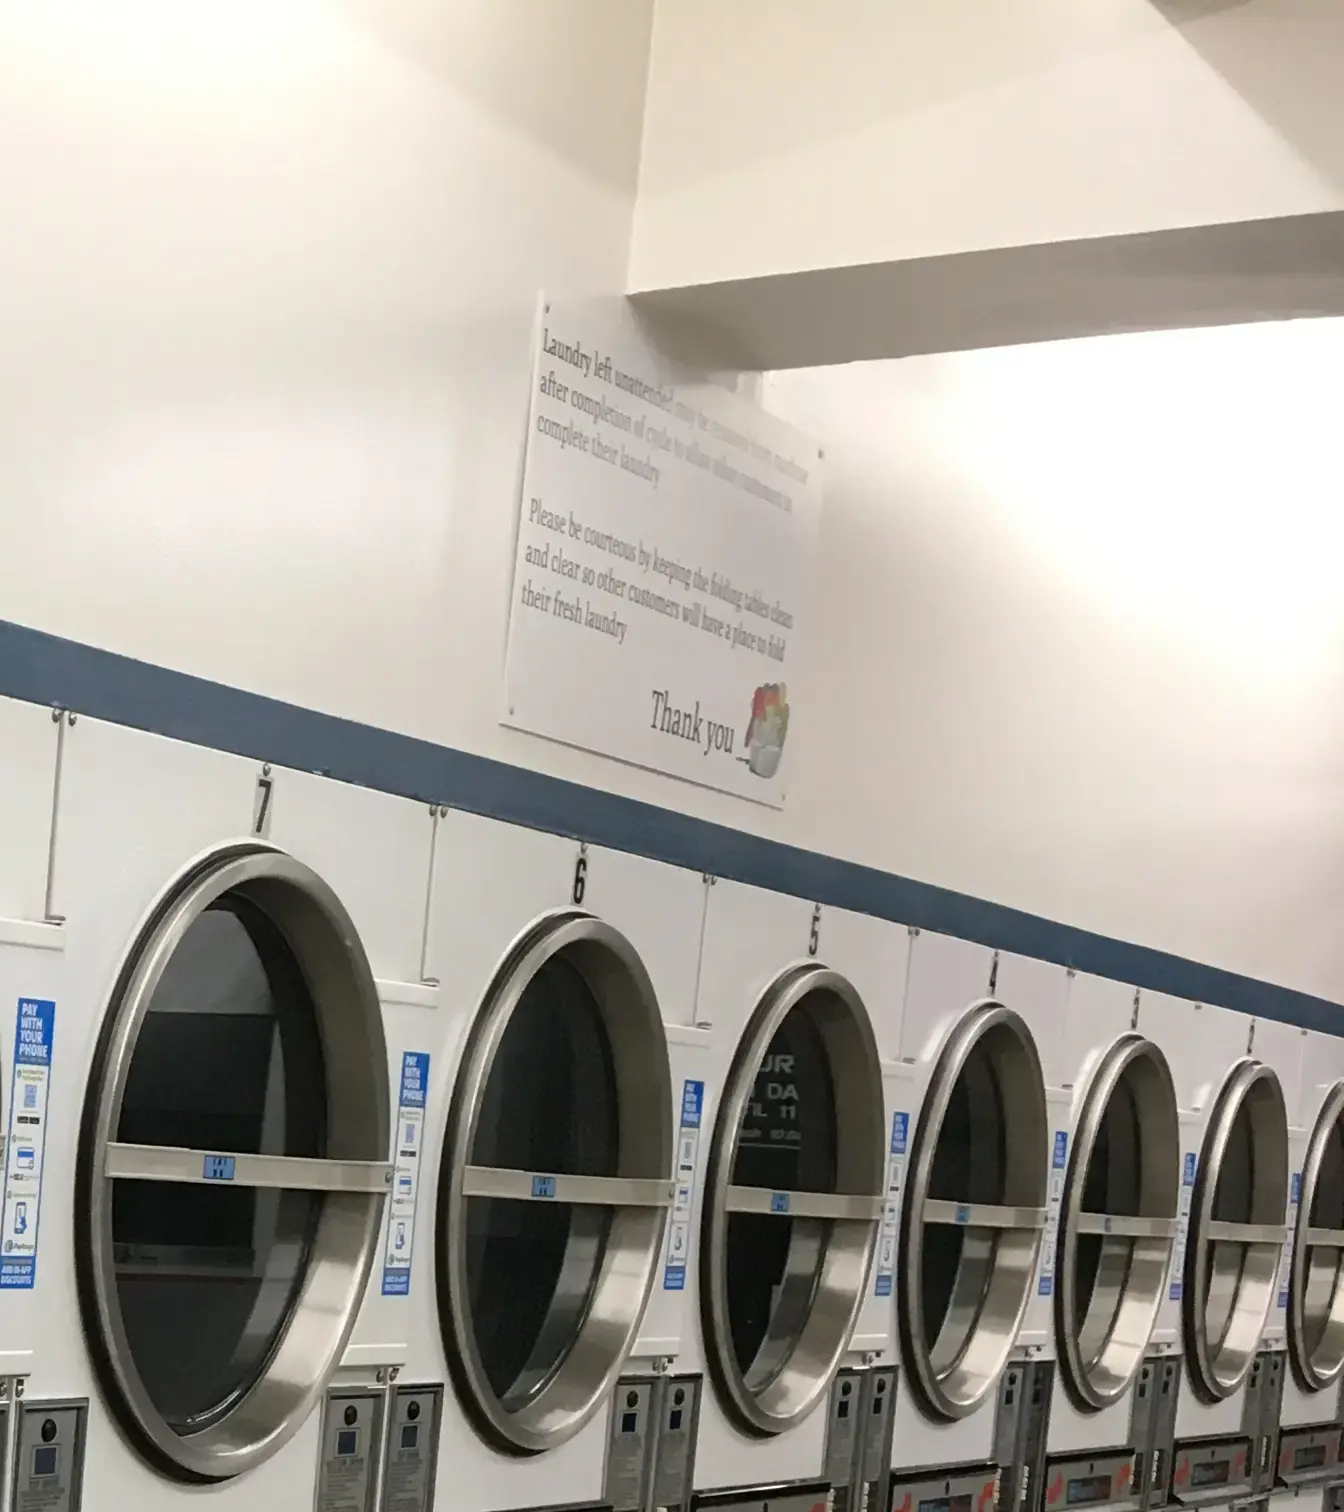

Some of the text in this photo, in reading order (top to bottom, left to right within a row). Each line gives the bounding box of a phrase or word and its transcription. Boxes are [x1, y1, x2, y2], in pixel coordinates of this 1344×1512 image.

[538, 370, 570, 403] after
[543, 327, 592, 378] Laundry
[594, 350, 613, 384] left
[537, 414, 661, 491] complete their laundry
[529, 496, 567, 535] Please
[568, 510, 583, 540] be
[583, 525, 637, 563] courteous
[637, 539, 653, 575] by
[652, 545, 692, 592] keeping
[520, 578, 629, 646] their fresh laundry
[524, 542, 551, 569] and
[550, 547, 582, 581] clear
[581, 568, 596, 587] so
[596, 566, 627, 599] other
[627, 583, 681, 620] customers
[724, 623, 732, 638] a
[650, 689, 736, 757] Thank you
[256, 778, 272, 834] 7
[572, 857, 587, 904] 6
[808, 914, 821, 956] 5
